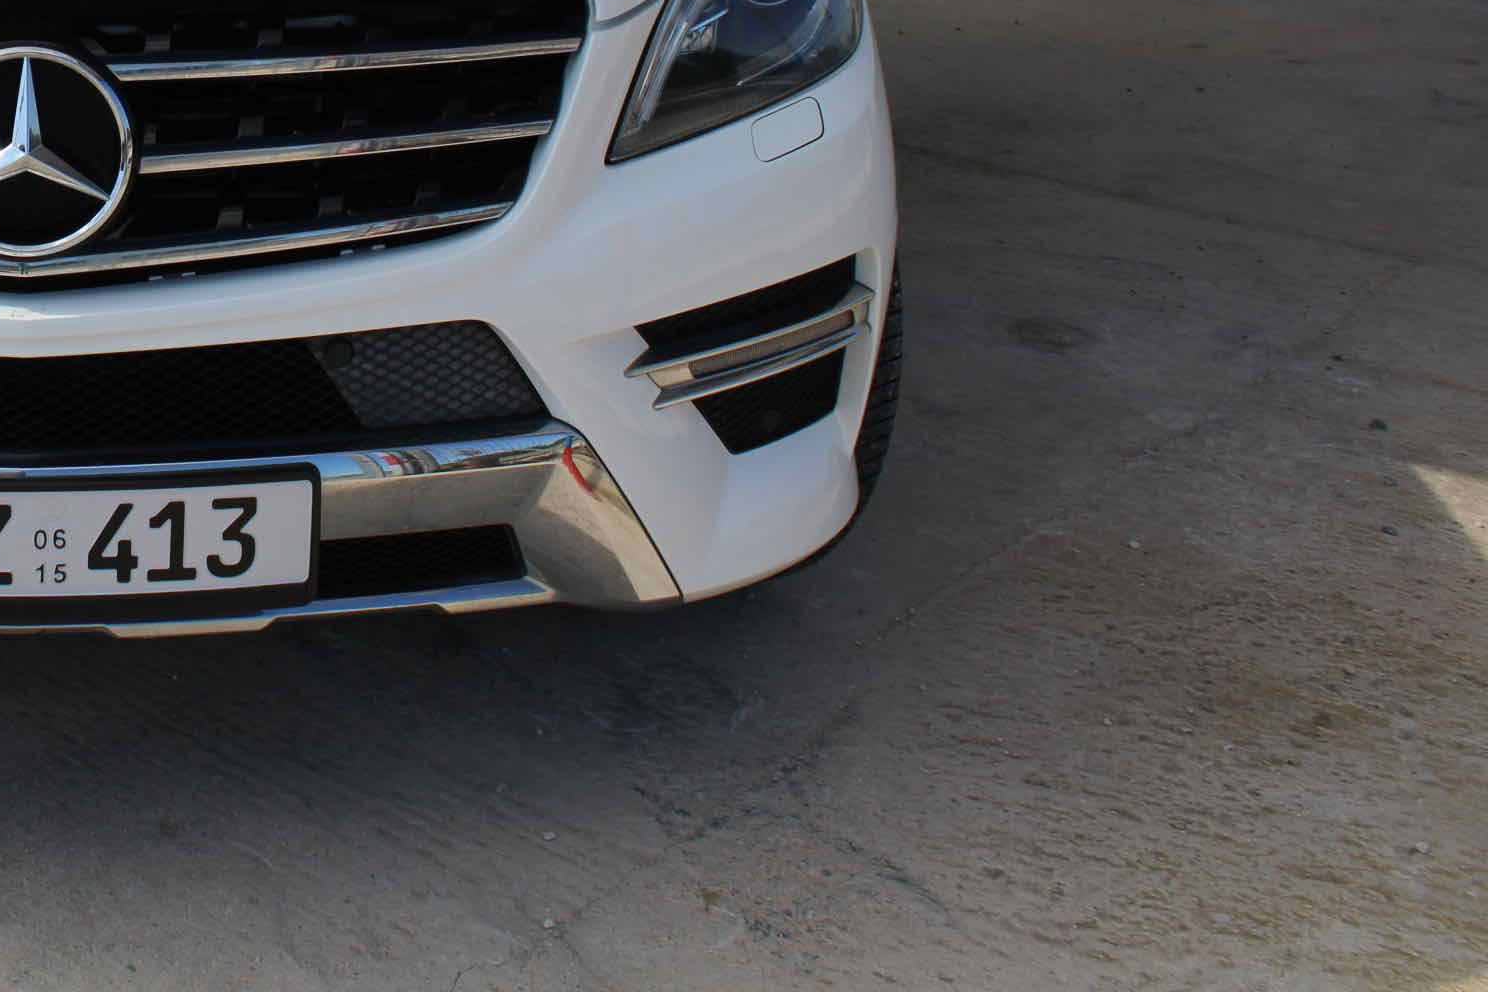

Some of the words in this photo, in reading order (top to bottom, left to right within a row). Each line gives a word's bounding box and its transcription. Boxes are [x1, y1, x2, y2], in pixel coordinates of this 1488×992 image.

[33, 529, 67, 550] 06
[87, 496, 258, 584] 413
[34, 563, 68, 584] 15
